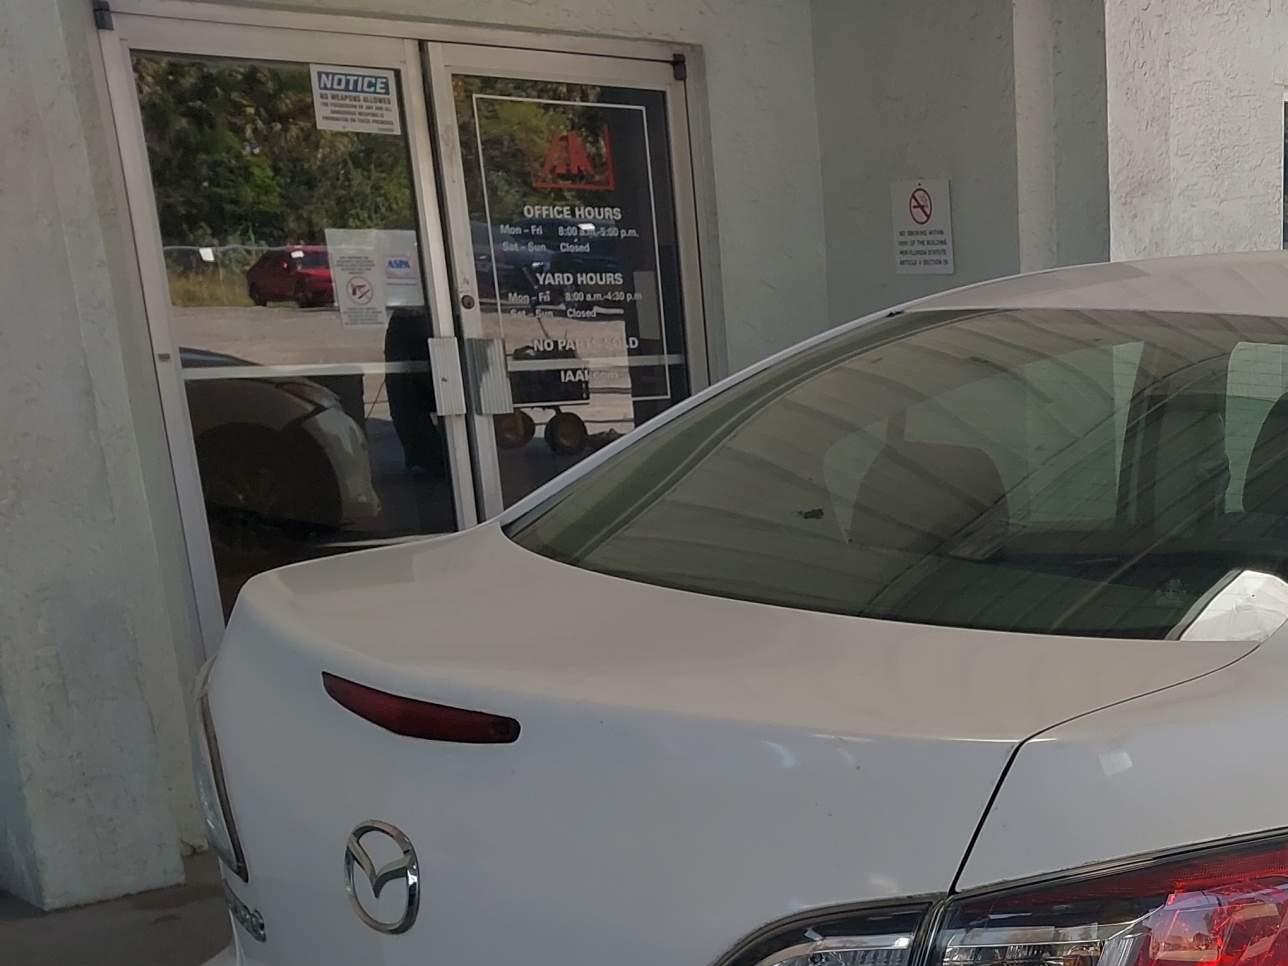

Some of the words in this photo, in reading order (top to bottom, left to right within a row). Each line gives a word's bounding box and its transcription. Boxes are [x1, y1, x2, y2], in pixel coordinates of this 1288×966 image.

[320, 73, 387, 93] NOTICE
[523, 204, 572, 219] OFFICE
[575, 206, 622, 220] HOURS
[500, 223, 522, 235] Mon
[531, 225, 543, 236] Fri
[558, 226, 577, 237] 8:00
[620, 229, 640, 240] p.m.
[502, 241, 520, 251] Sat
[527, 241, 546, 252] Sun
[560, 242, 591, 253] Closed
[536, 272, 574, 285] YARD
[577, 272, 623, 285] HOURS
[508, 292, 530, 305] Mon
[538, 291, 551, 302] Fri
[565, 291, 584, 302] 8:00
[566, 307, 597, 319] Closed
[533, 339, 555, 352] NO
